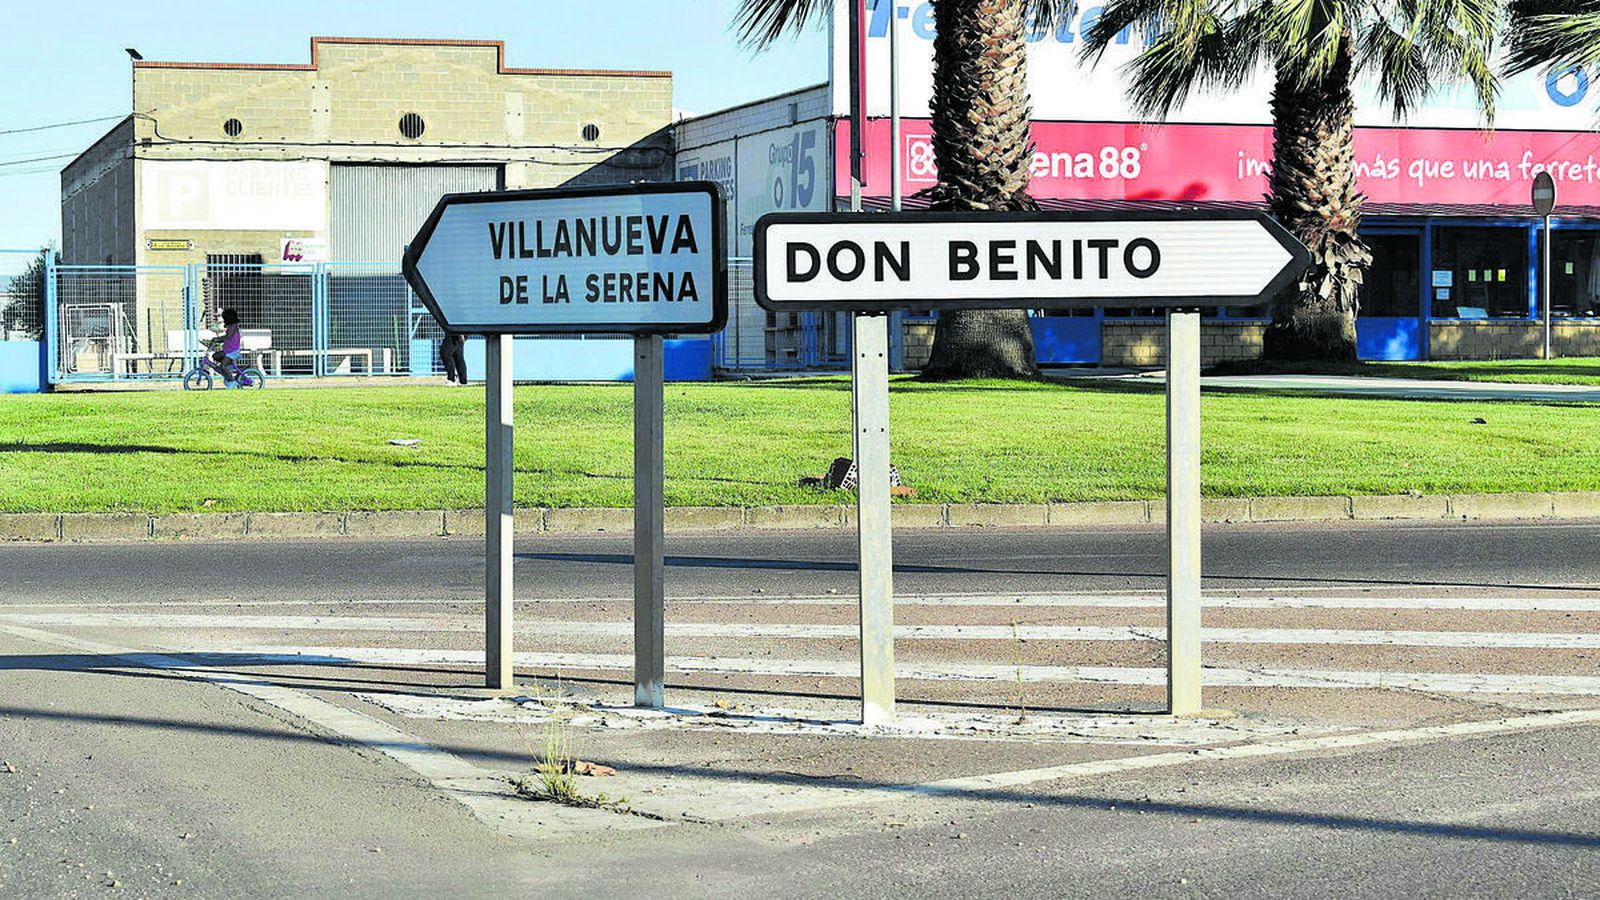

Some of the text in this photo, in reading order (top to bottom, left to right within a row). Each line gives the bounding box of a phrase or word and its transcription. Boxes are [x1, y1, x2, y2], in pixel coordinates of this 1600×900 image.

[701, 157, 732, 180] PARKING
[791, 130, 816, 208] 15
[1353, 154, 1399, 178] más
[1408, 157, 1455, 187] que
[1463, 158, 1510, 179] una
[488, 214, 699, 260] VILLANUEVA
[786, 237, 1161, 283] DON BENITO
[499, 271, 699, 305] DE LA SERENA
